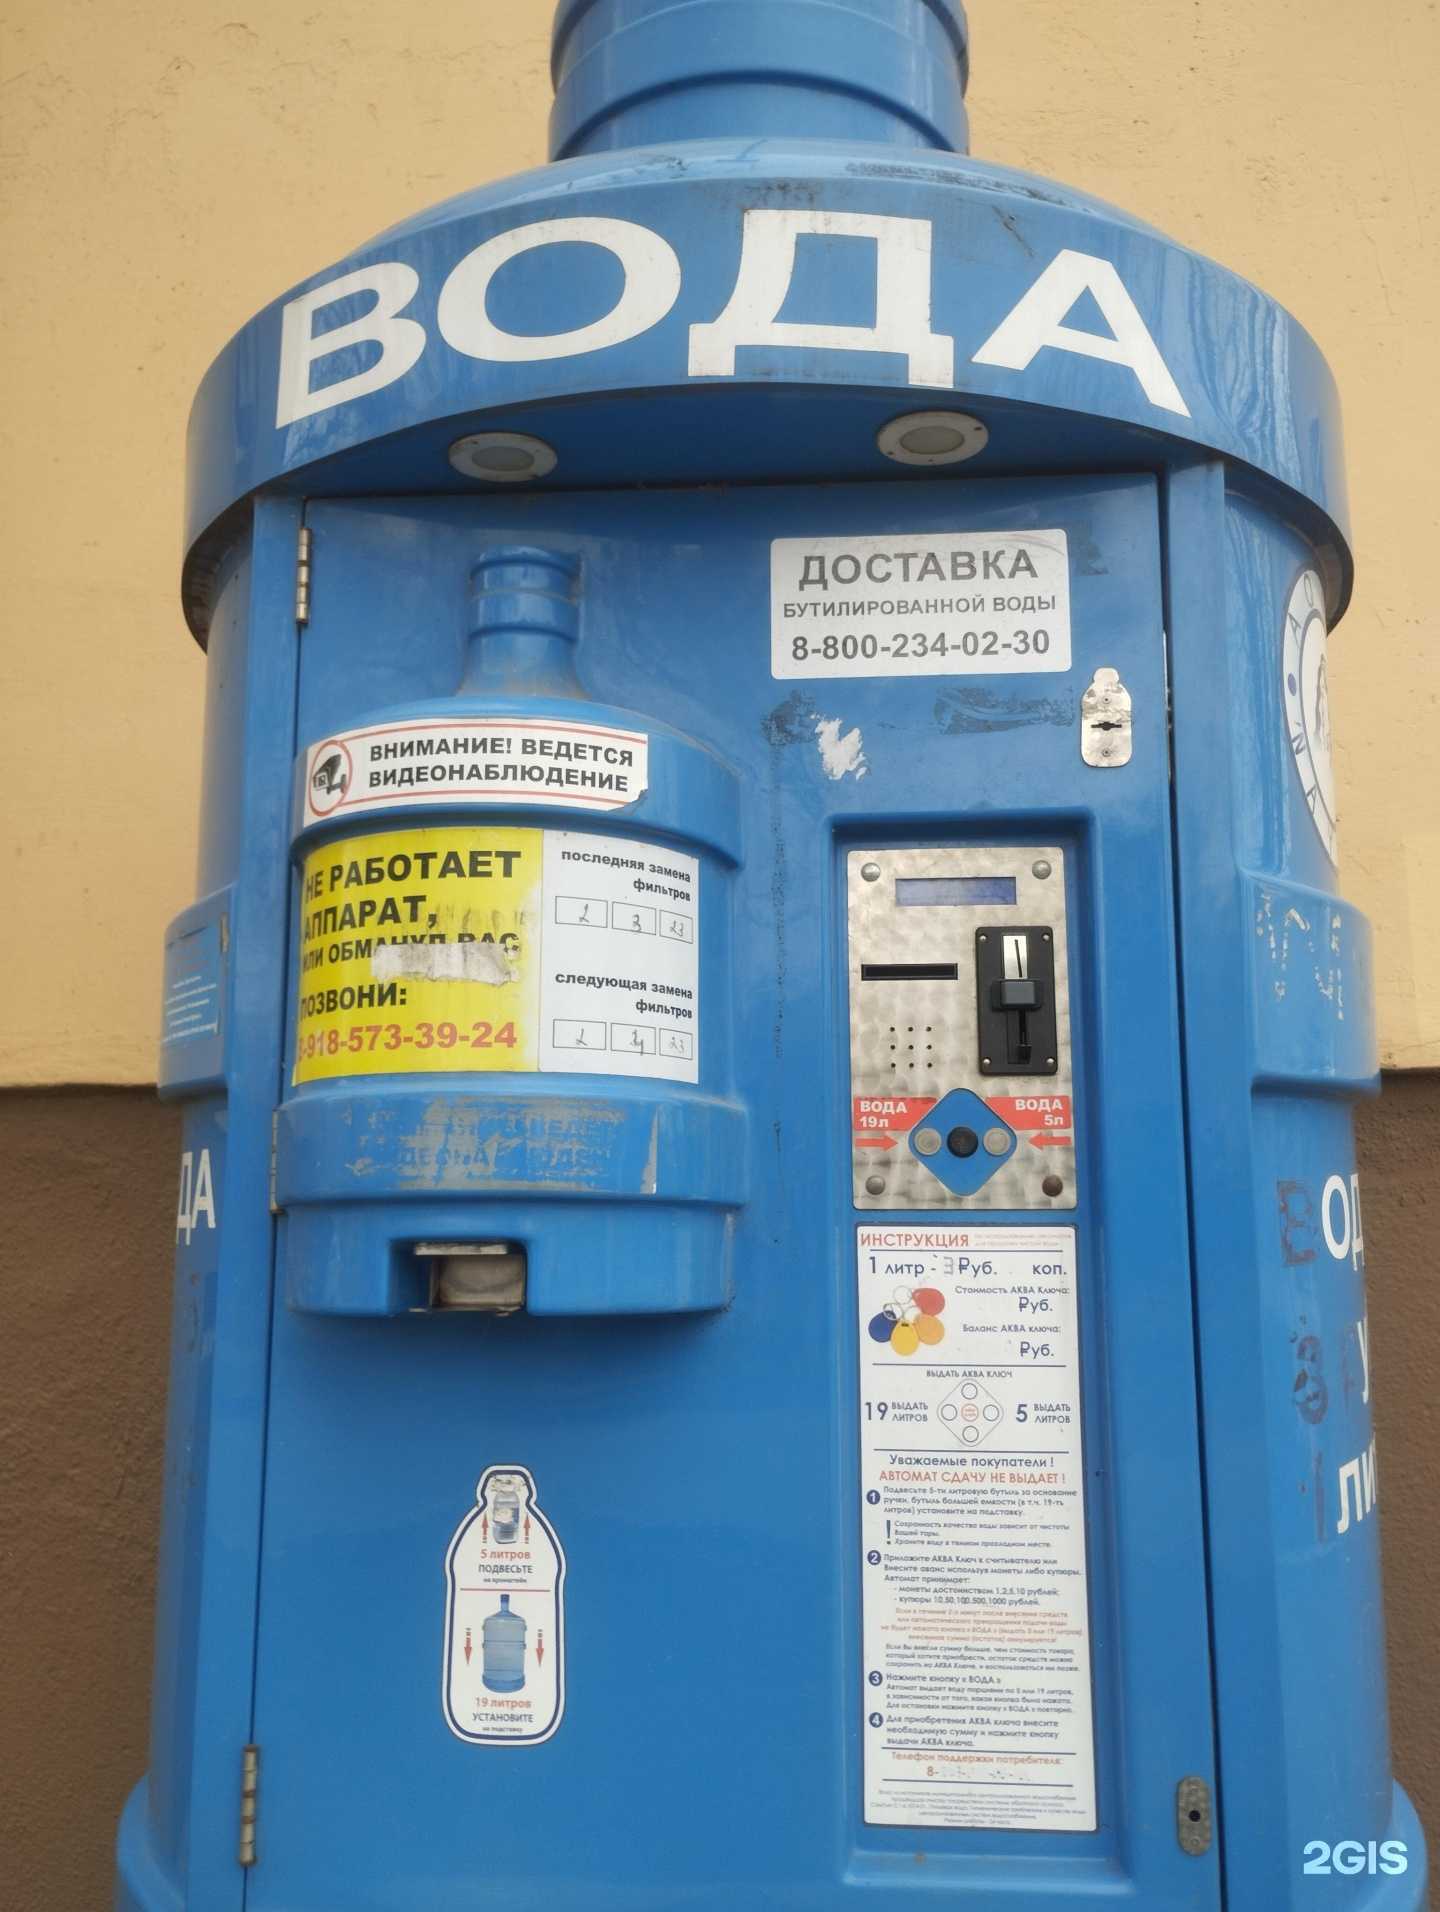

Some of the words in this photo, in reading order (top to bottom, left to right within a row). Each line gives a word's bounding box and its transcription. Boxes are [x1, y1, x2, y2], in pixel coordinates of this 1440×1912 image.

[276, 209, 1191, 430] ВОДА
[798, 549, 1039, 591] ДОСТАВКА
[783, 595, 985, 618] БУТИЛИРОВАННОЙ
[993, 596, 1056, 614] ВОДЫ
[792, 629, 1050, 661] 8-800-234-02-30
[370, 737, 512, 763] ВНИМАНИЕ!
[521, 739, 634, 768] ВЕДЕТСЯ
[368, 764, 629, 793] ВИДЕОНАБЛЮДЕНИЕ
[561, 850, 645, 873] последняя
[649, 863, 692, 884] замена
[305, 870, 324, 904] НЕ
[329, 850, 522, 892] РАБОТАЕТ
[633, 878, 692, 903] фильтров
[555, 973, 648, 992] следующая
[651, 983, 693, 1000] замена
[299, 982, 407, 1021] ПОЗВОНИ:
[636, 998, 693, 1018] фильтров
[860, 1101, 908, 1115] ВОДА
[1015, 1099, 1063, 1111] ВОДА
[860, 1116, 889, 1128] 19л
[1044, 1114, 1064, 1127] 5л
[861, 1233, 969, 1248] ИНСТРУКЦИЯ
[868, 1256, 876, 1274] 1
[885, 1262, 924, 1278] литр
[1033, 1264, 1068, 1275] коп.
[955, 1286, 1008, 1295] Стоимость
[1010, 1287, 1035, 1295] АКВА
[1037, 1287, 1071, 1296] Ключа:
[963, 1324, 999, 1333] Баланс
[1001, 1325, 1026, 1333] АКВА
[1029, 1326, 1062, 1334] ключа:
[926, 1369, 960, 1379] ВЫДАТЬ
[961, 1370, 984, 1379] АКВА
[986, 1370, 1013, 1379] КЛЮЧ
[864, 1401, 889, 1421] 19
[892, 1402, 928, 1411] ВЫДАТЬ
[892, 1413, 928, 1423] ЛИТРОВ
[1015, 1403, 1028, 1423] 5
[1033, 1404, 1071, 1413] ВЫДАТЬ
[1033, 1415, 1071, 1425] ЛИТРОВ
[889, 1454, 967, 1468] Уважаемые
[971, 1457, 1049, 1470] покупатели
[879, 1470, 938, 1483] АВТОМАТ
[942, 1472, 985, 1485] СДАЧУ
[990, 1473, 1007, 1483] НЕ
[1009, 1473, 1060, 1487] ВЫДАЕТ
[480, 1549, 487, 1559] 5
[489, 1551, 531, 1562] литров
[478, 1564, 534, 1575] ПОДВЕСЬТЕ
[475, 1697, 488, 1708] 19
[490, 1699, 531, 1710] литров
[472, 1712, 534, 1723] УСТАНОВИТЕ
